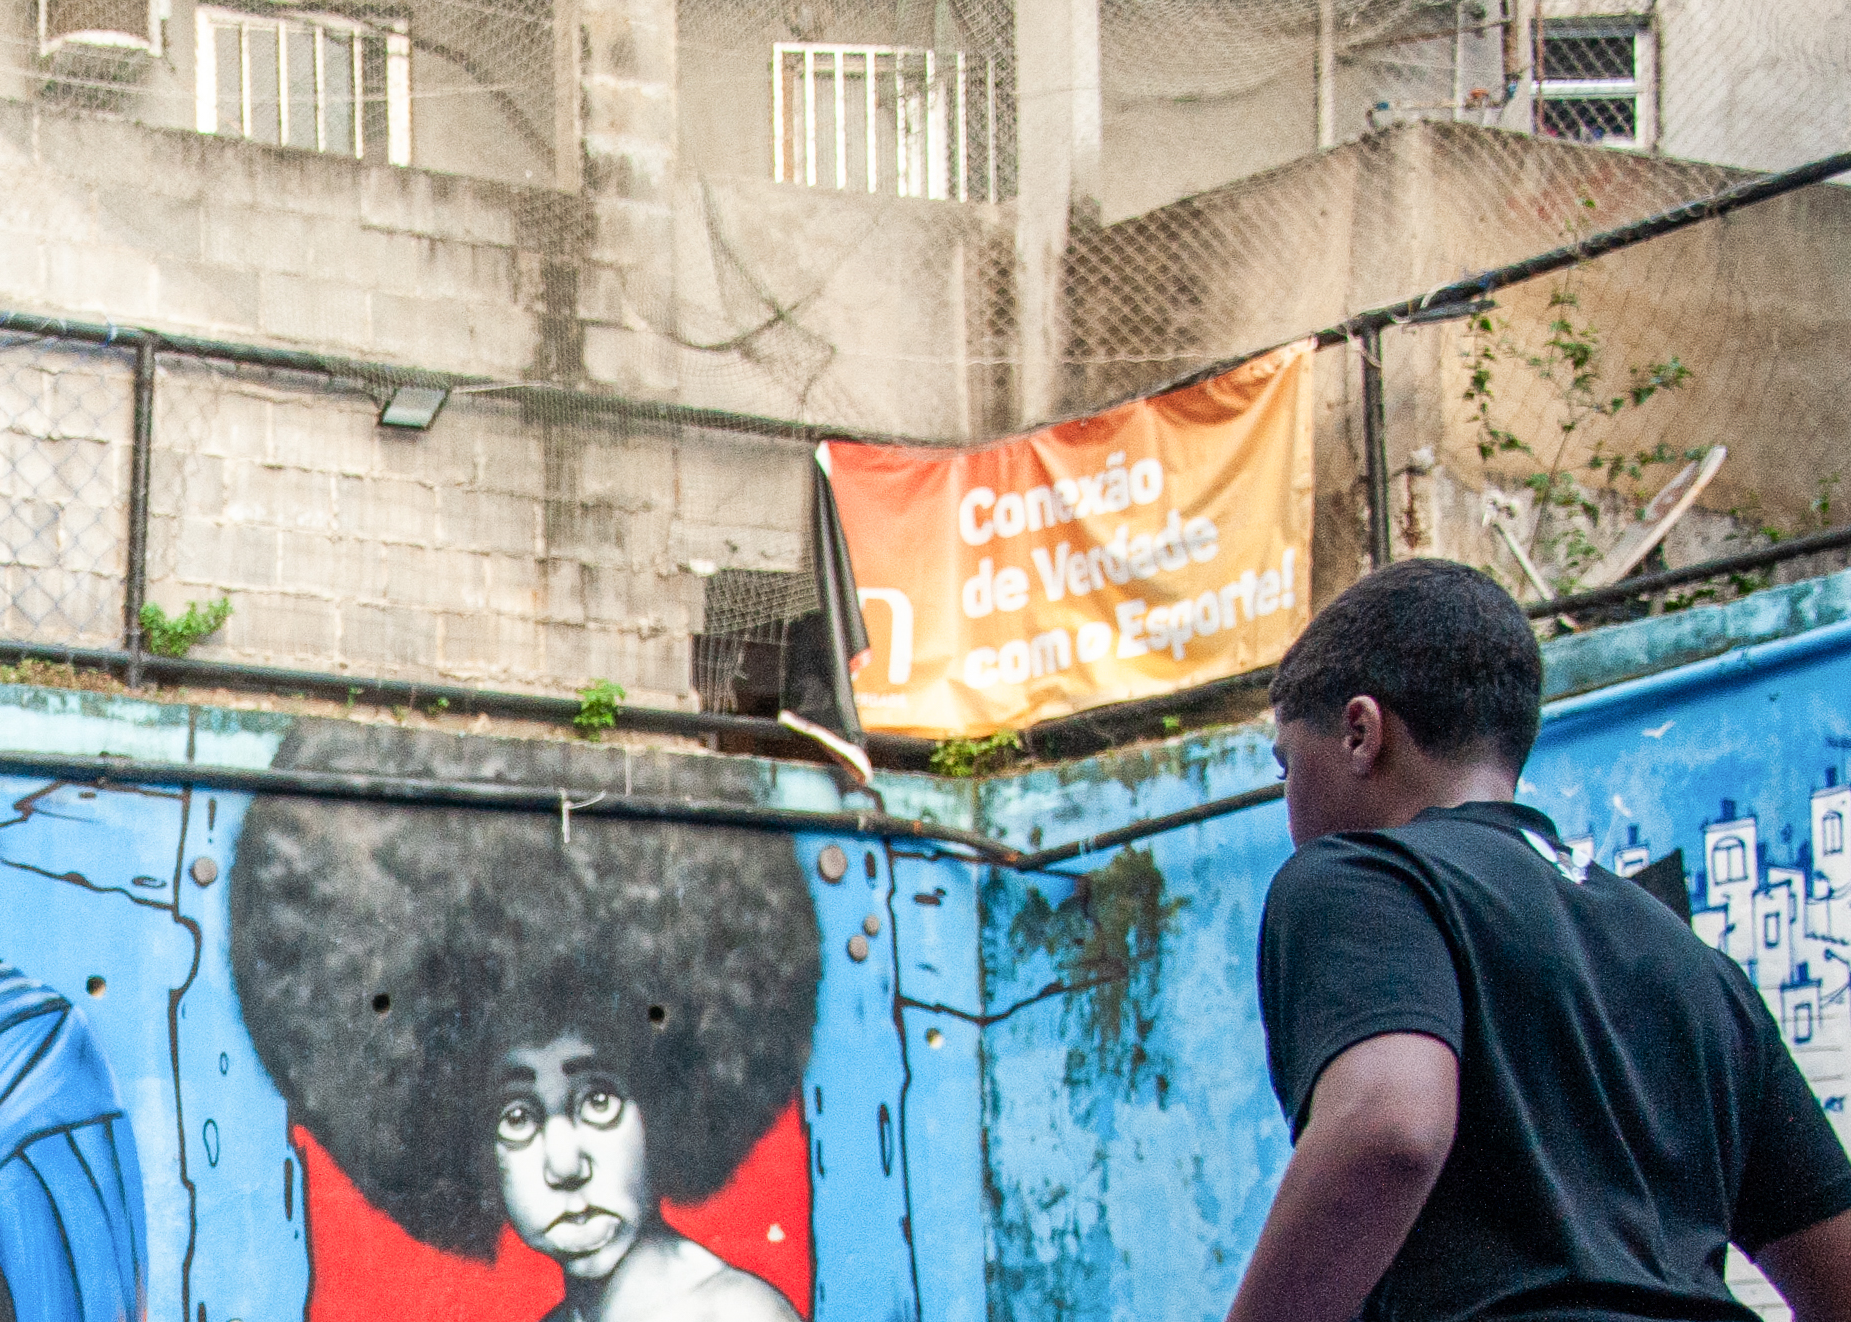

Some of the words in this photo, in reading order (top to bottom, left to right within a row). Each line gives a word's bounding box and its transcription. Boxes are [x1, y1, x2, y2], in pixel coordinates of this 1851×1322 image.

[958, 451, 1163, 546] Conexão
[961, 558, 1030, 620] de
[1031, 508, 1219, 602] Verdade
[962, 625, 1072, 690] com
[1076, 620, 1113, 665] o
[1116, 547, 1297, 661] Esporte!
